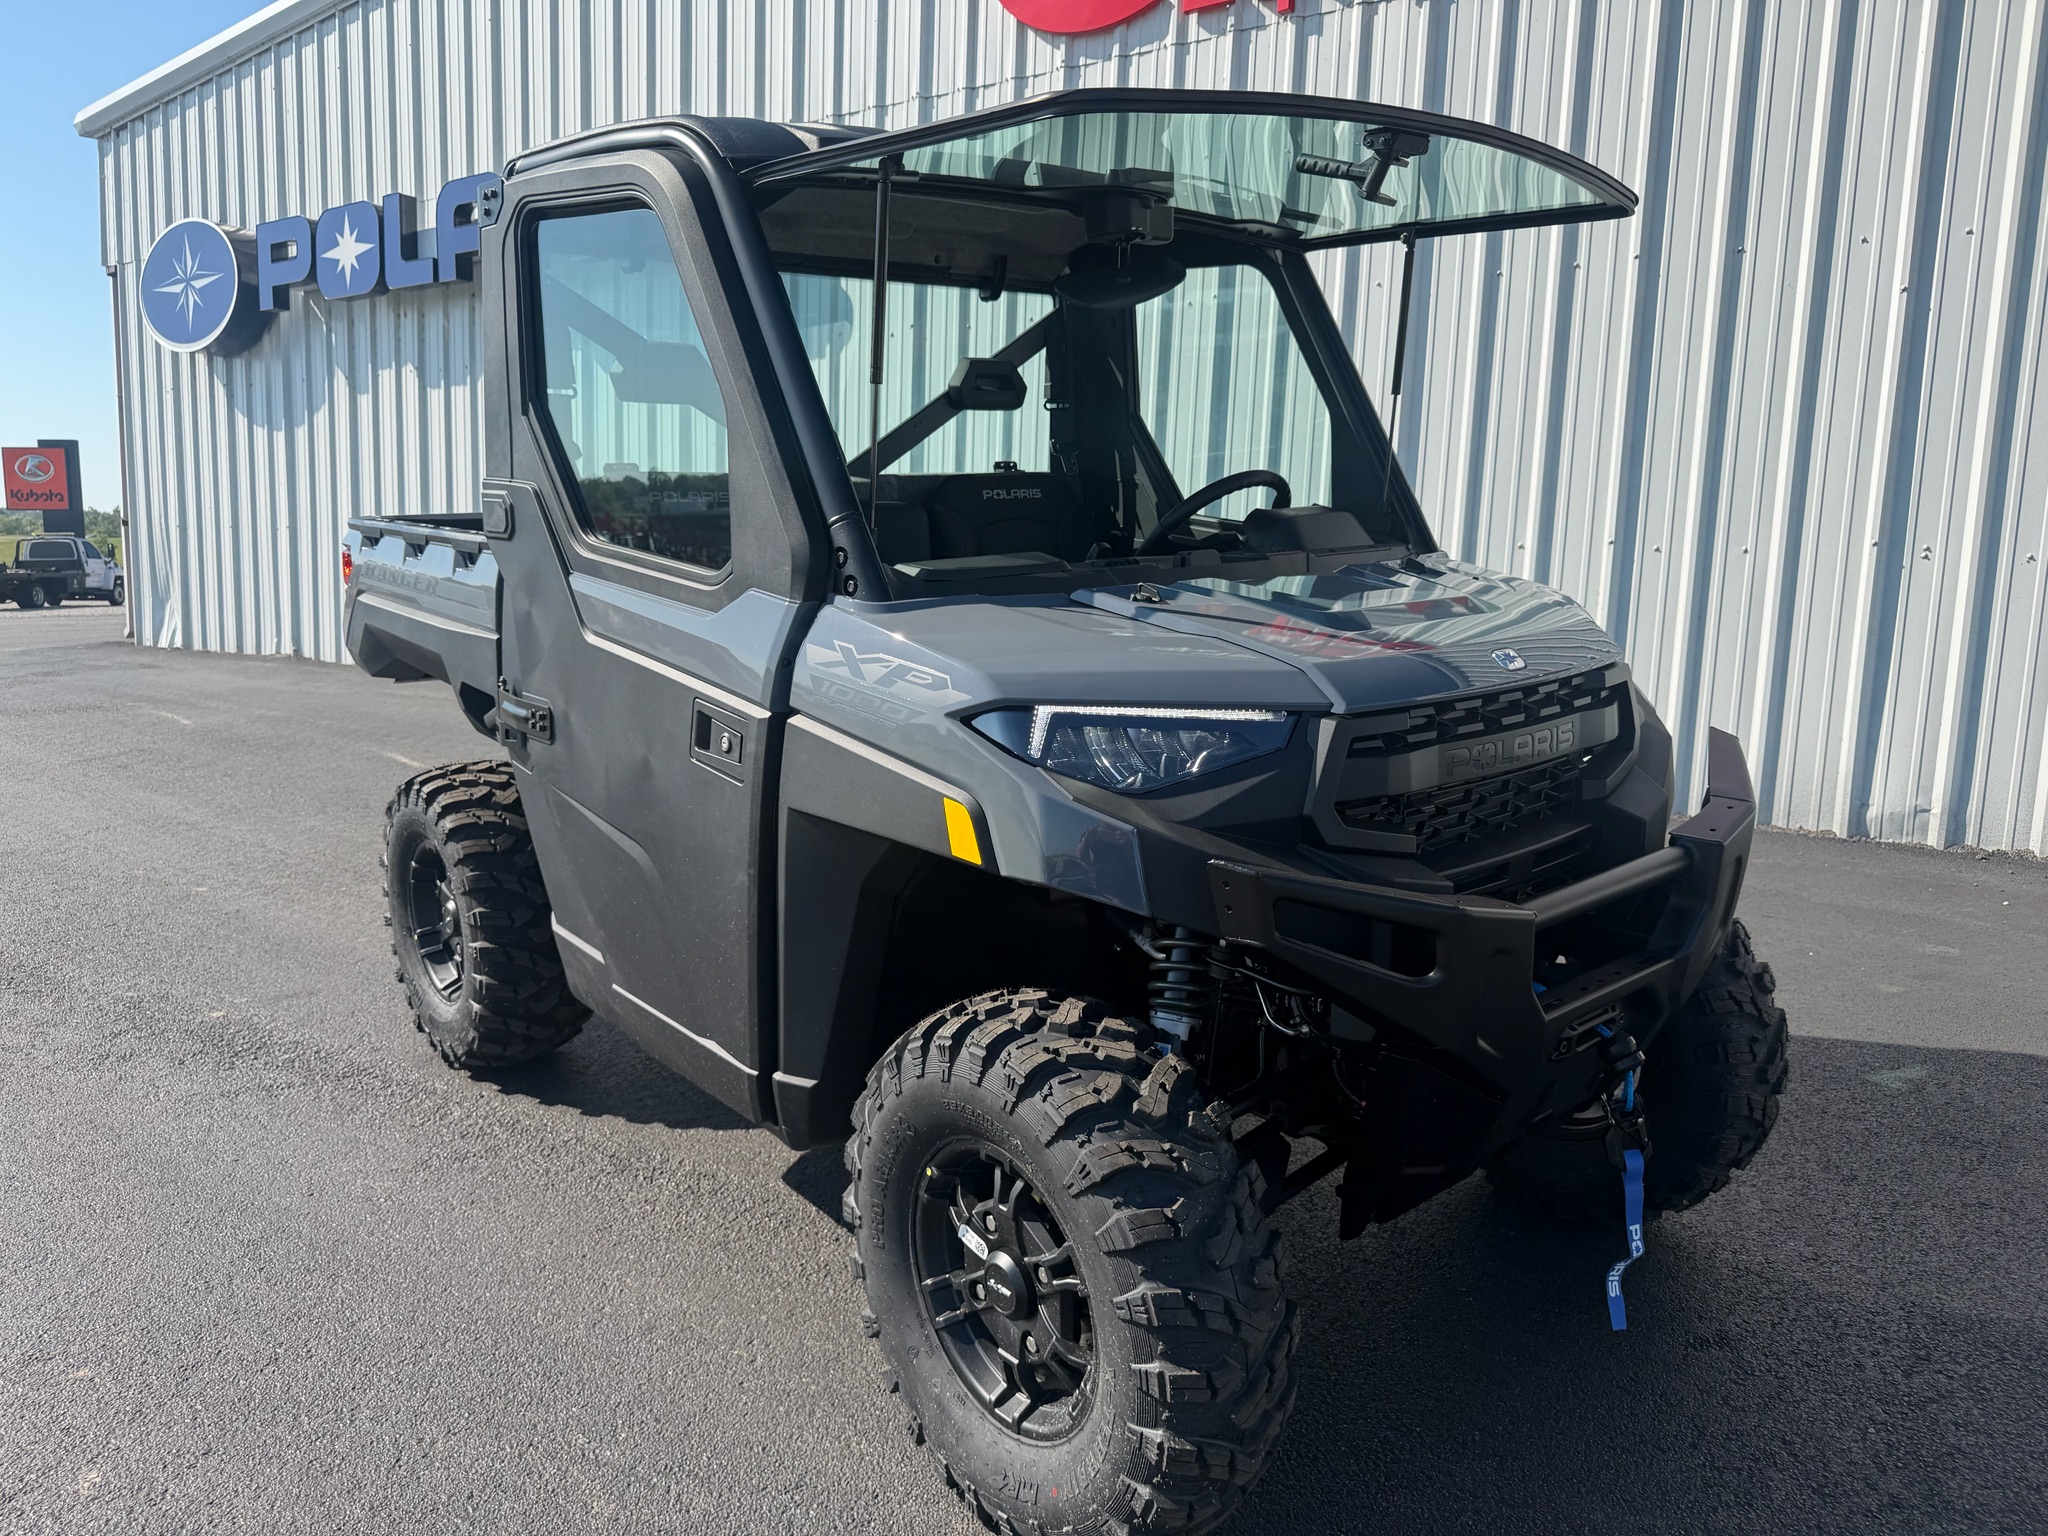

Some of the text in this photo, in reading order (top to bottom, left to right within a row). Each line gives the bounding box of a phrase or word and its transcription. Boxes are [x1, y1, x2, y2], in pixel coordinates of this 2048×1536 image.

[10, 488, 65, 502] Kubota
[649, 491, 729, 503] POLARIS
[982, 488, 1042, 500] POLARIS
[363, 560, 441, 596] RANGER
[813, 639, 953, 691] XP
[817, 679, 909, 721] 1000
[1446, 720, 1576, 777] POLARIS
